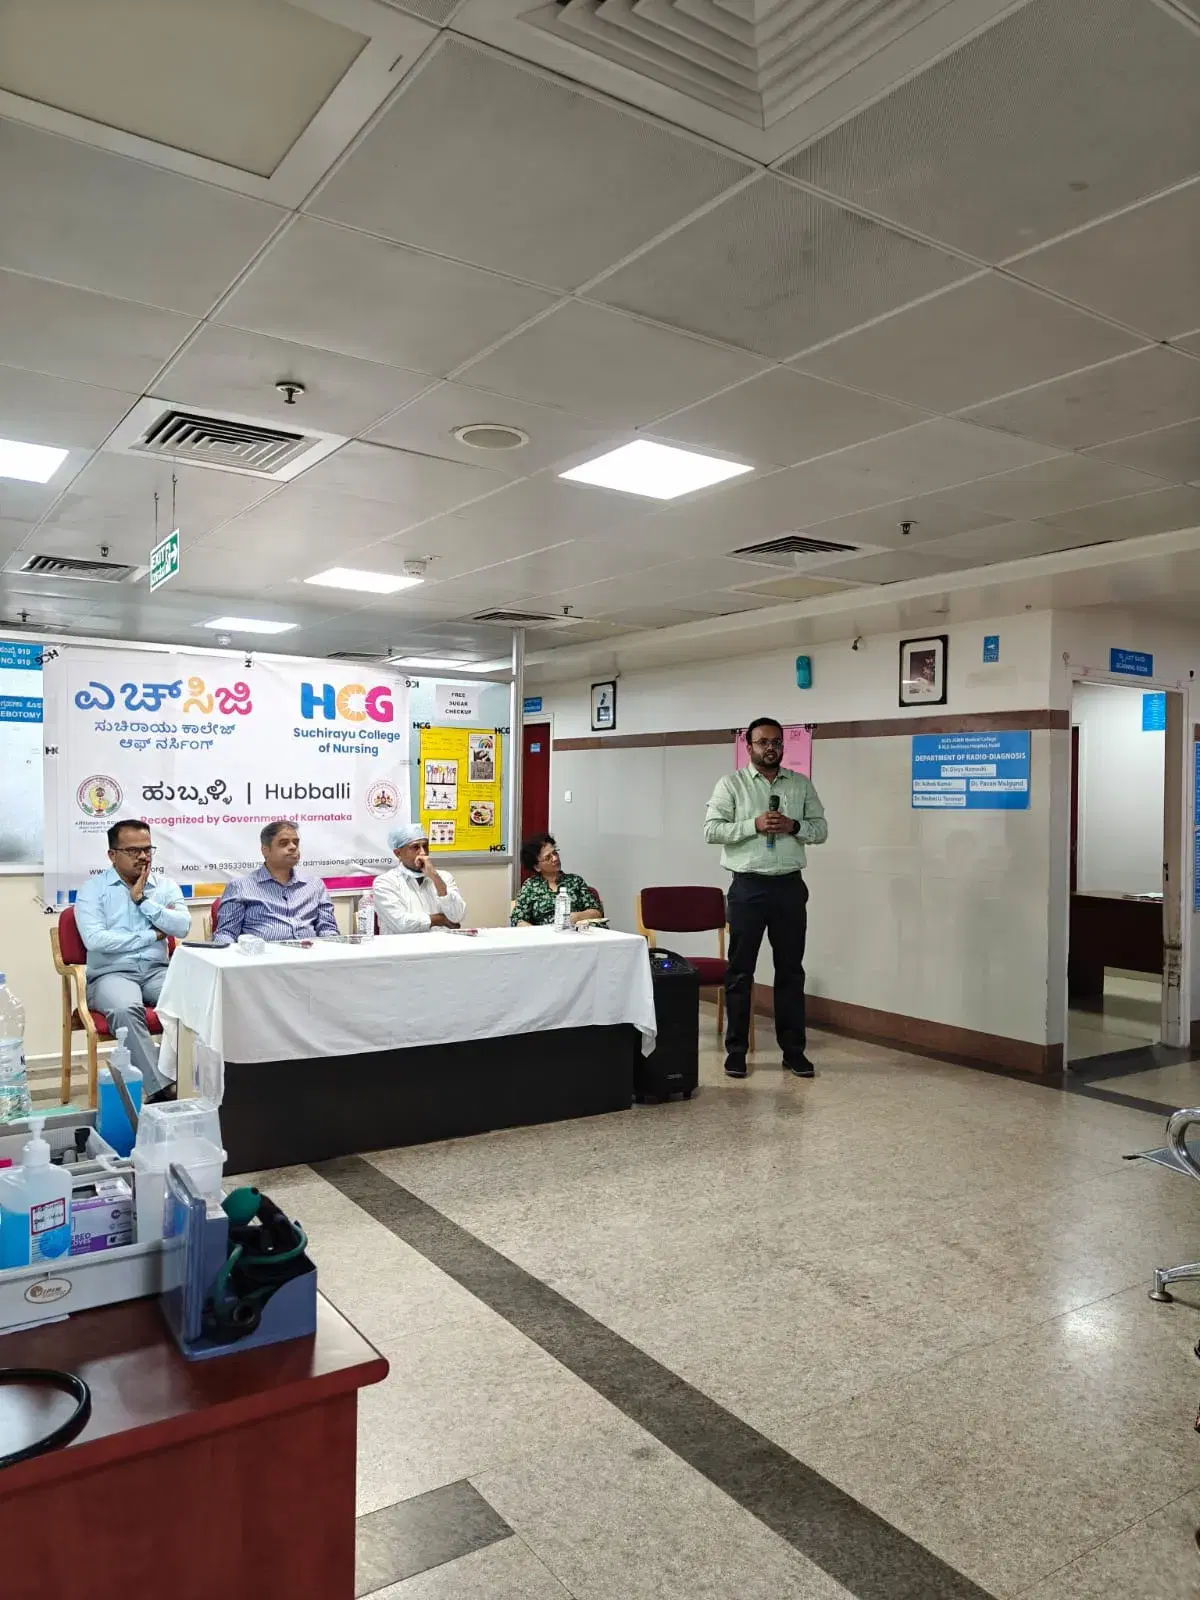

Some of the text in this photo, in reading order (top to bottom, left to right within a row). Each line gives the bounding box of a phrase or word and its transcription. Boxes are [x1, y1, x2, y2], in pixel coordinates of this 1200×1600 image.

[301, 682, 394, 723] HCG
[0, 710, 41, 718] EBOTOMY
[94, 719, 236, 735] ಸುಚಿರಾಯು ಕಾಲೇಜ್
[293, 728, 400, 742] Suchirayu College
[119, 737, 213, 751] ಆಫ್ ನರ್ಸಿಂಗ್
[318, 743, 379, 756] of Nursing
[966, 752, 1026, 760] RADIO-DIAGNOSIS
[142, 779, 232, 805] ಹುಬ್ಬಳ್ಳಿ
[265, 782, 350, 800] Hubballi
[140, 813, 352, 827] Recognized by Government of Karnataka
[489, 844, 506, 852] HCG
[182, 863, 199, 871] Mob:
[203, 863, 217, 871] +91
